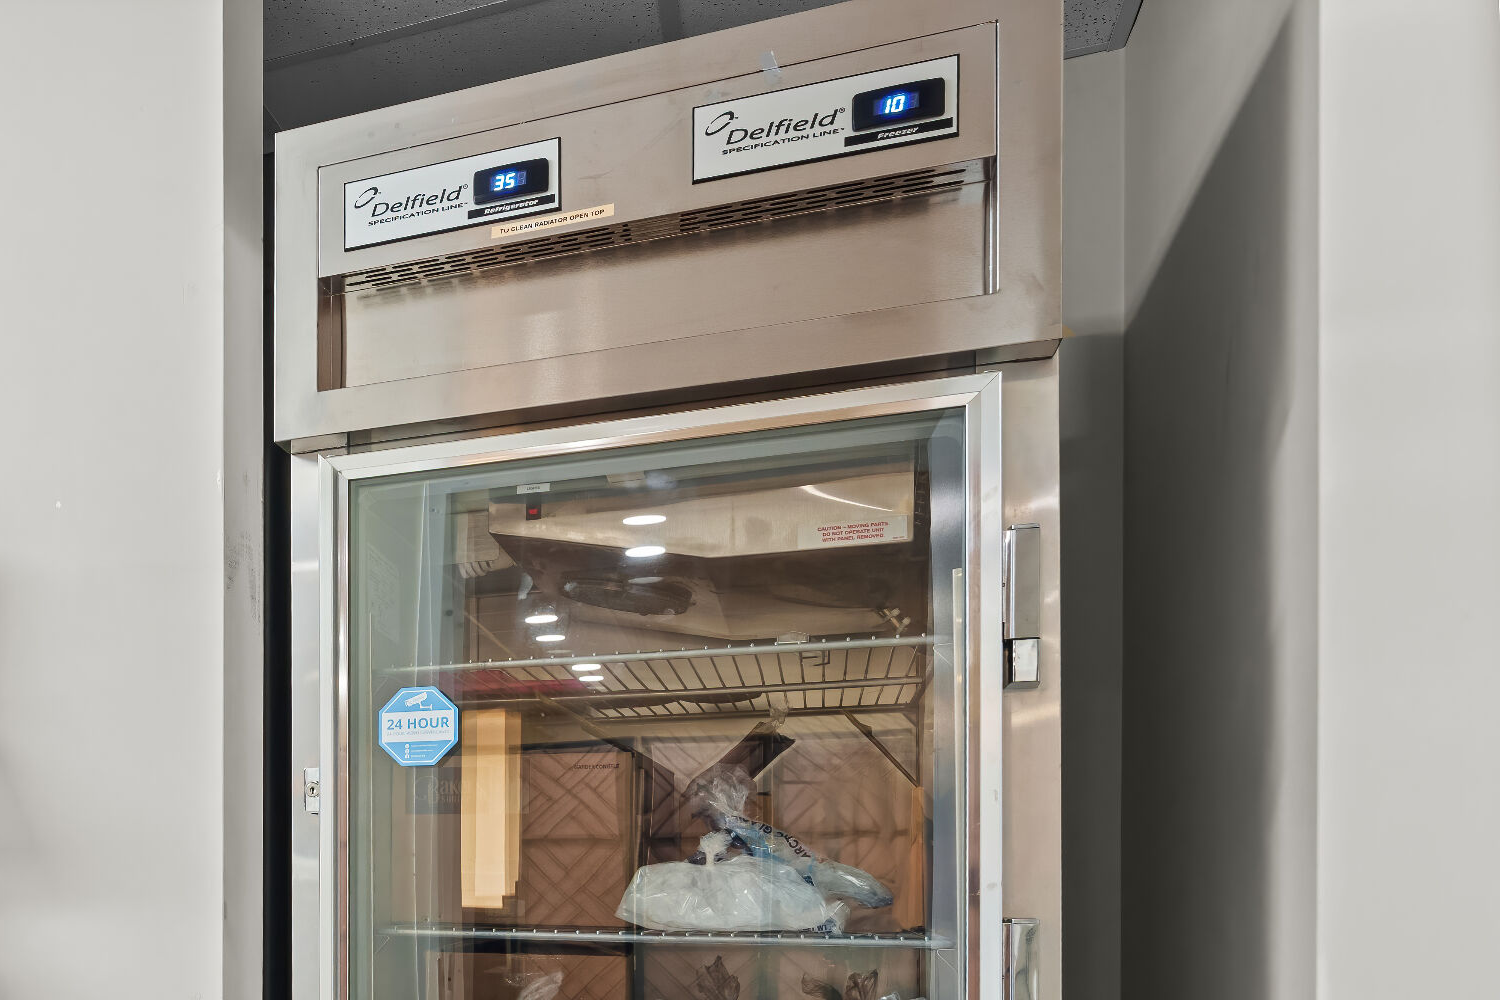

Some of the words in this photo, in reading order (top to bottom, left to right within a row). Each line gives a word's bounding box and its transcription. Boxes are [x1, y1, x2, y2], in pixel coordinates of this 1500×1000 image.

[885, 95, 906, 114] 10
[726, 108, 838, 146] Delfield
[877, 126, 919, 140] Freezer
[722, 134, 810, 156] SPECIFICATION
[812, 128, 840, 139] LINE
[493, 172, 516, 192] 35
[371, 185, 463, 218] Delfield
[483, 199, 539, 216] Refrigerator
[368, 207, 440, 227] SPECIFICATION
[441, 202, 465, 213] LINE
[510, 223, 533, 233] CLEAN
[534, 216, 568, 229] RADIATOR
[569, 212, 590, 222] OPEN
[591, 208, 605, 217] TOP
[386, 718, 403, 731] 24
[407, 716, 450, 729] HOUR
